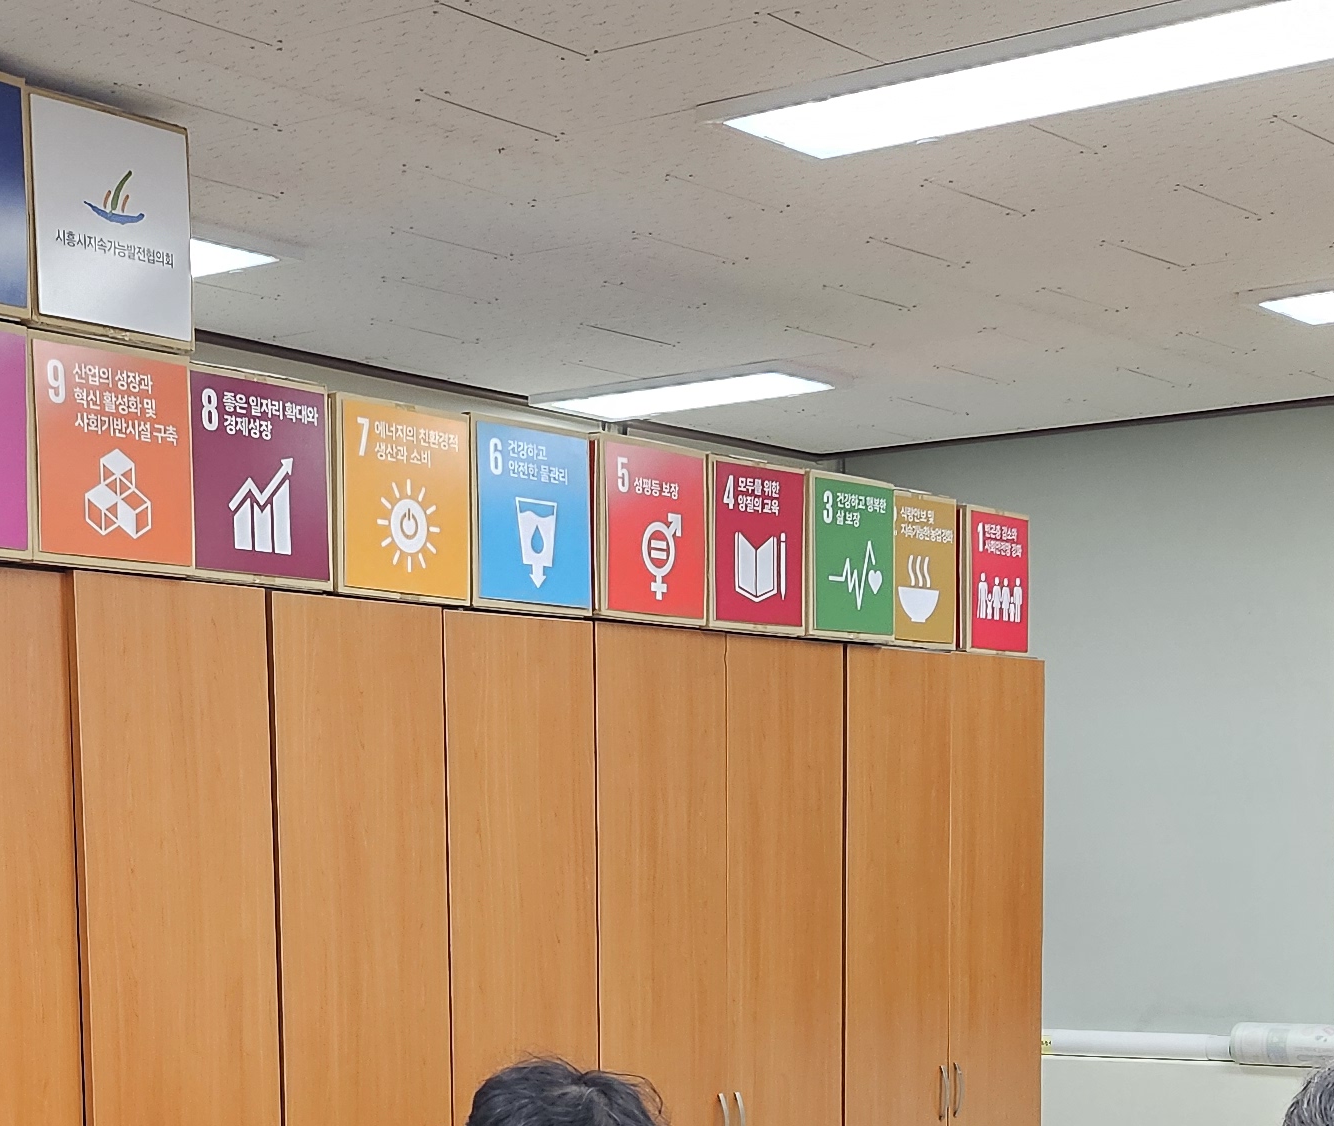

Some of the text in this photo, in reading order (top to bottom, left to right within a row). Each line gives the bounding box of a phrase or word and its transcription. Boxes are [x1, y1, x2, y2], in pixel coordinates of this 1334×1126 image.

[55, 229, 175, 268] 시흥시지속가능발전협의회
[47, 359, 66, 404] 9
[73, 362, 153, 394] 산업의 성장과
[73, 387, 157, 419] 혁신 활성화 및
[202, 387, 218, 431] 8
[223, 391, 319, 427] 좋은 일자리 확대와
[74, 411, 179, 446] 사회기반시설 구축
[223, 416, 273, 442] 경제성장
[356, 416, 370, 457] 7
[374, 420, 459, 452] 에너지의 친환경적
[374, 442, 431, 469] 생산과 소비
[489, 437, 503, 477] 6
[507, 438, 547, 462] 건강하고
[508, 458, 568, 486] 안전한 물관리
[617, 456, 629, 493] 5
[737, 476, 780, 499] 모두를 위한
[662, 481, 679, 500] 보장
[723, 474, 734, 510] 4
[737, 494, 780, 517] 양질의 교육
[836, 492, 887, 514] 건강하고 행복한
[823, 490, 833, 524] 3
[845, 511, 860, 528] 보장
[977, 522, 984, 552] 1
